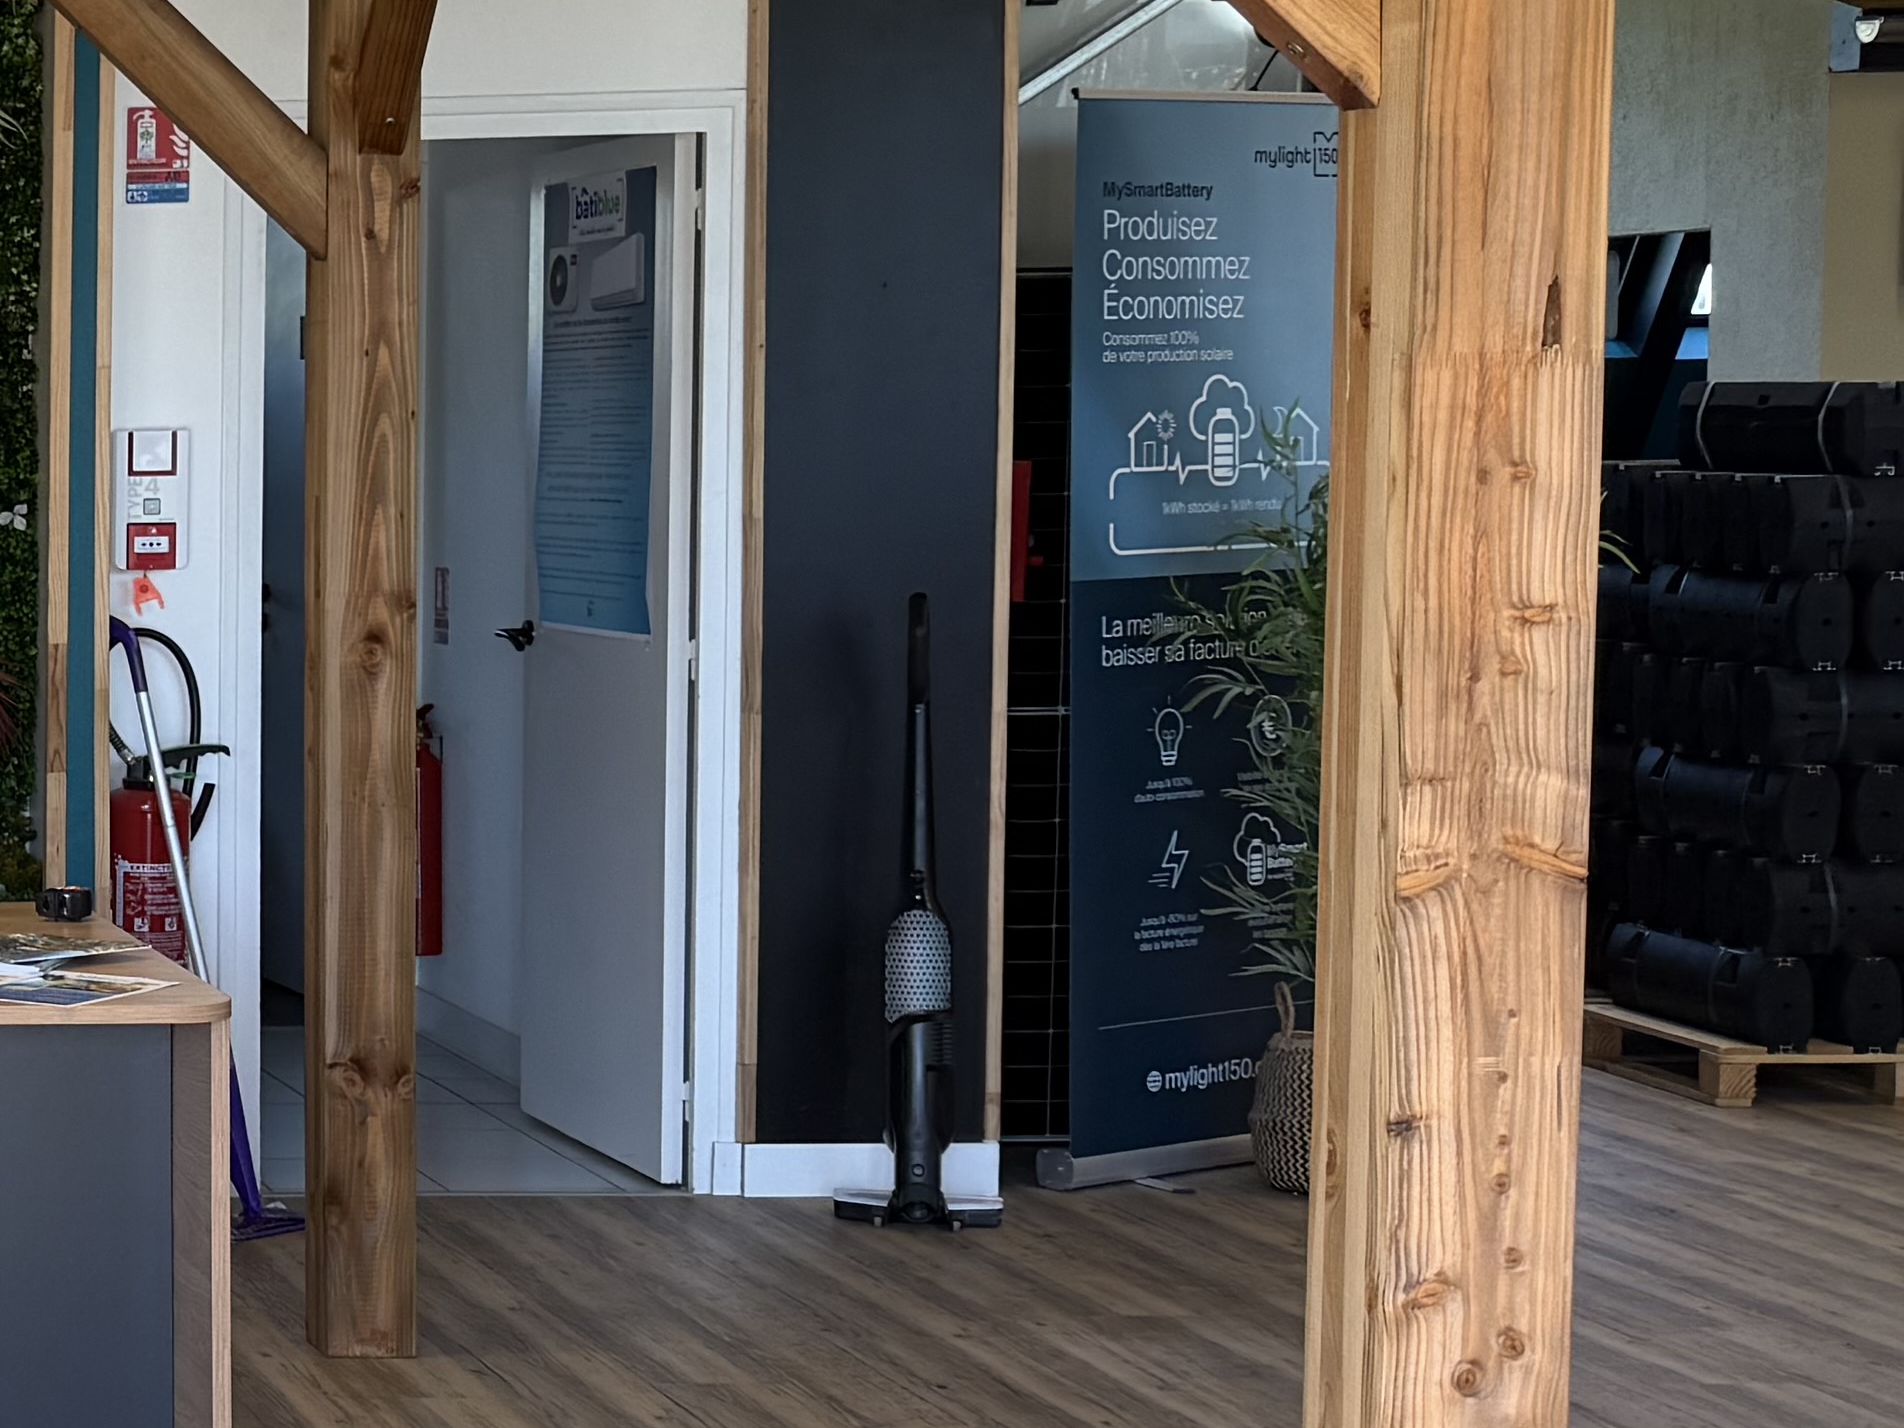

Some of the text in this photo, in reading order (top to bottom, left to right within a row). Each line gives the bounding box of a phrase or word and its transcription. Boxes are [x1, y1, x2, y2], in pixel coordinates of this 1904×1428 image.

[1254, 146, 1312, 169] mylight
[1103, 181, 1213, 201] MySmartBattery
[1103, 209, 1219, 241] Produisez
[1103, 248, 1251, 280] Consommez
[1103, 282, 1245, 320] Économisez
[1102, 331, 1168, 346] Consommez
[1101, 615, 1123, 638] La
[1101, 644, 1162, 667] baisser
[1165, 644, 1186, 663] sa
